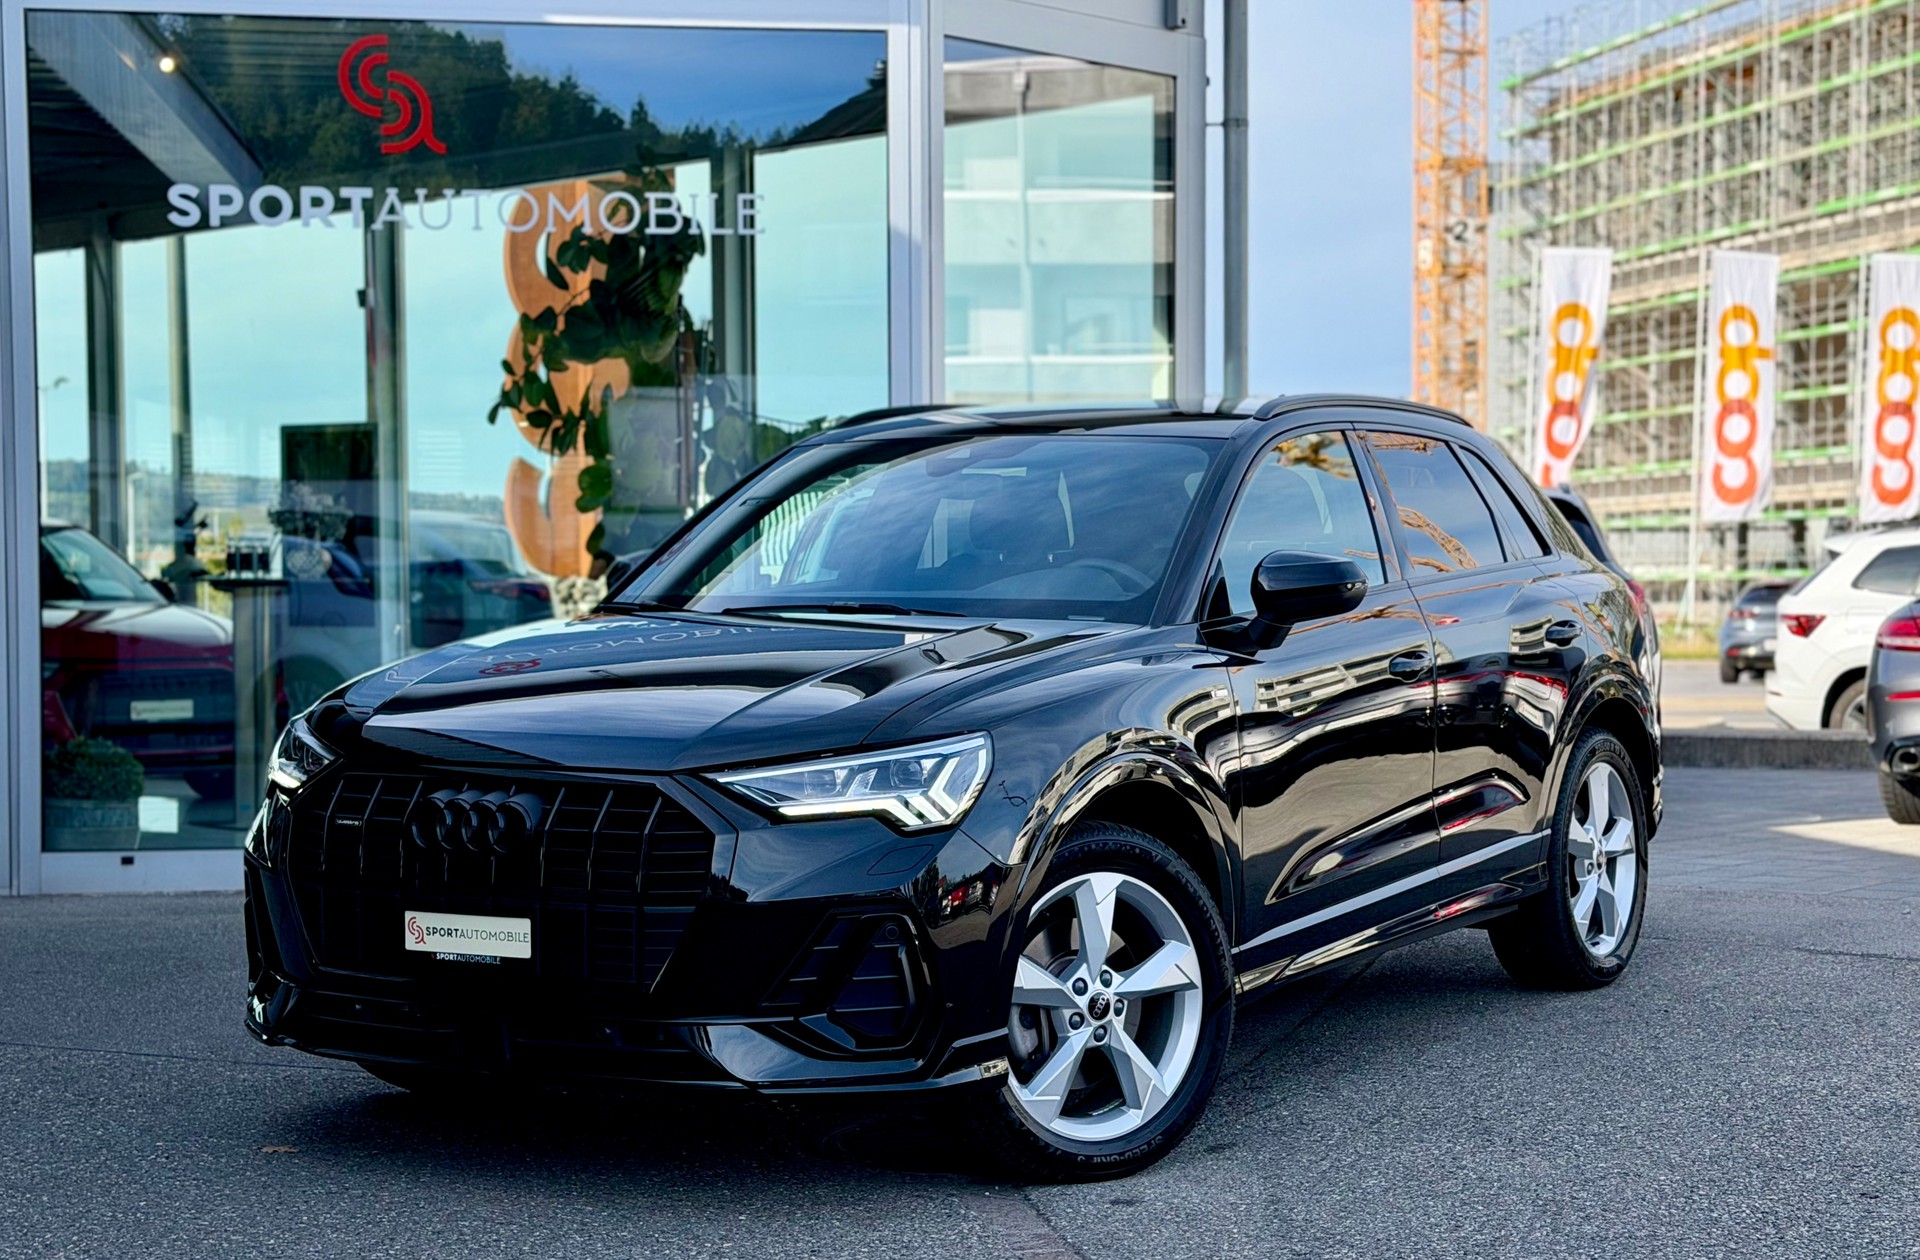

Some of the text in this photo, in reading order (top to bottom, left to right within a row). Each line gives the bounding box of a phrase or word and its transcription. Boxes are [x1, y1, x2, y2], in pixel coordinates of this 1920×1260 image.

[166, 183, 766, 236] SPORTAUTOMOBILE
[1712, 304, 1776, 506] coop
[425, 926, 530, 943] SPORTAUTOMOBILE
[435, 952, 501, 965] SPORTAUTOMOBILE
